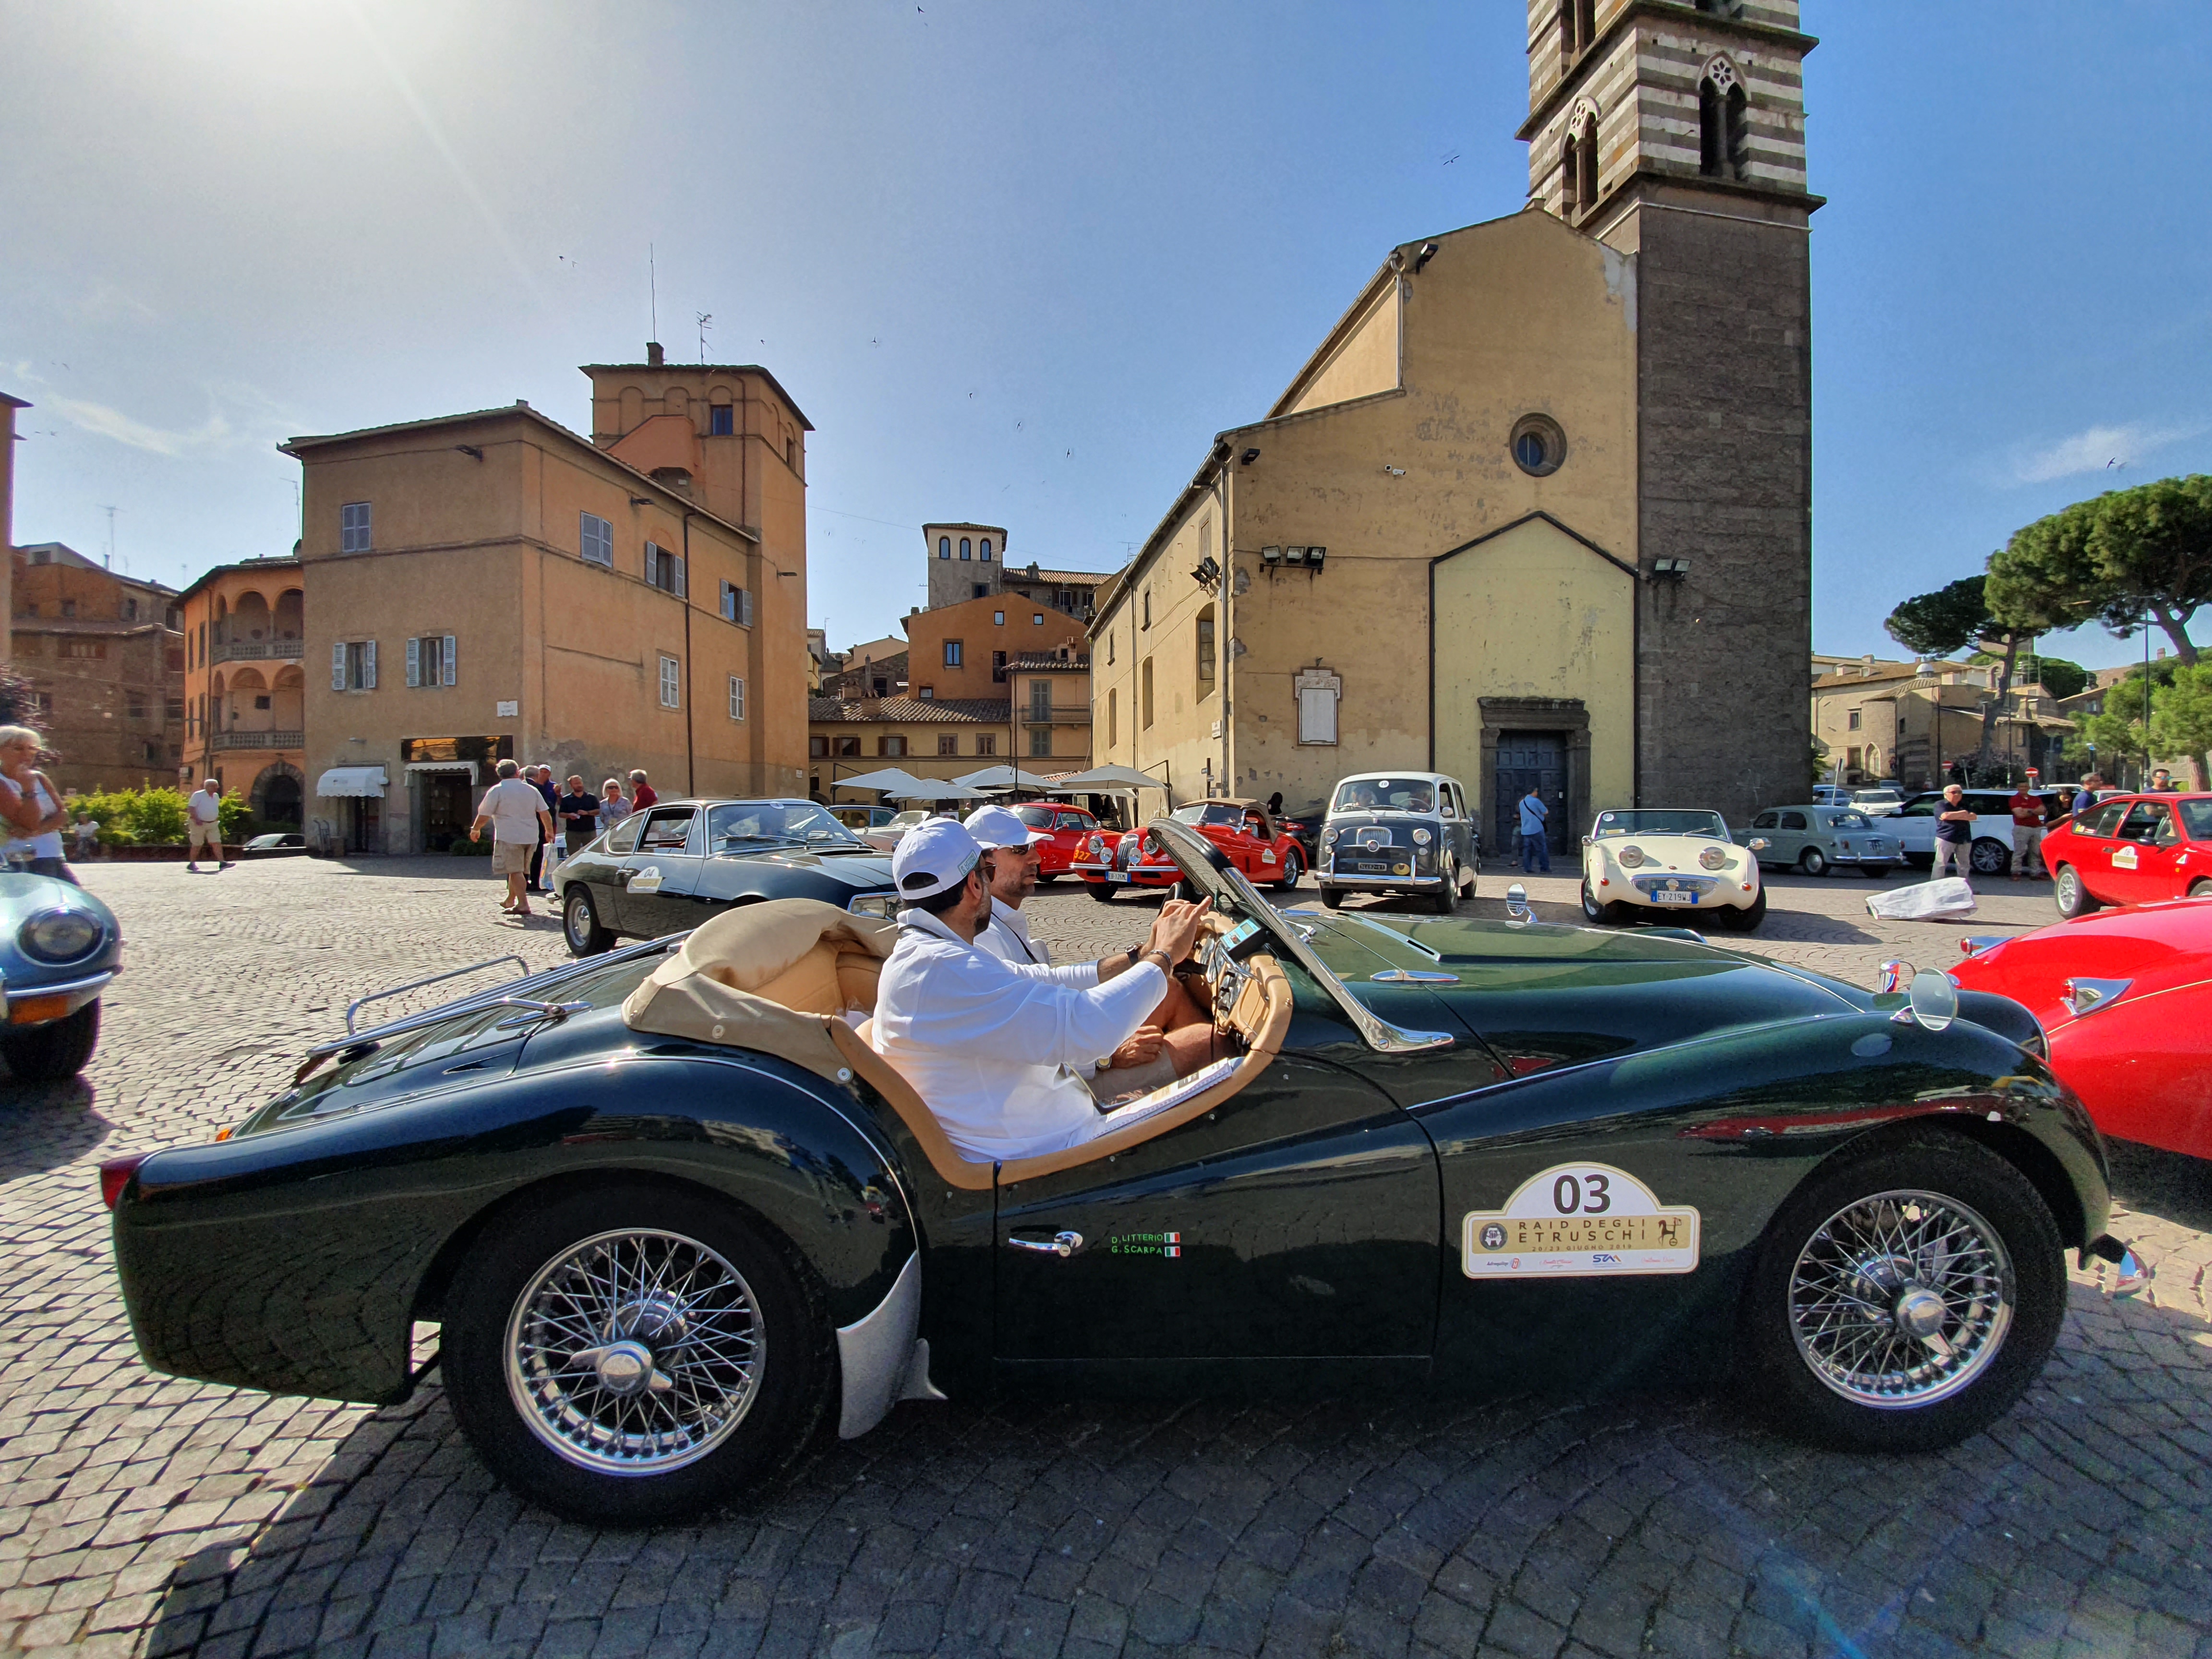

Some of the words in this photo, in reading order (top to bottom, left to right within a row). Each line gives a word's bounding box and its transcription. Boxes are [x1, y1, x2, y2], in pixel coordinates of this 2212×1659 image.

[1074, 849, 1091, 861] 327
[644, 869, 655, 878] 04
[1553, 1174, 1611, 1214] 03
[1519, 1221, 1569, 1230] RAID
[1584, 1218, 1645, 1228] DEGLI
[1518, 1229, 1645, 1243] ETRUSCHI
